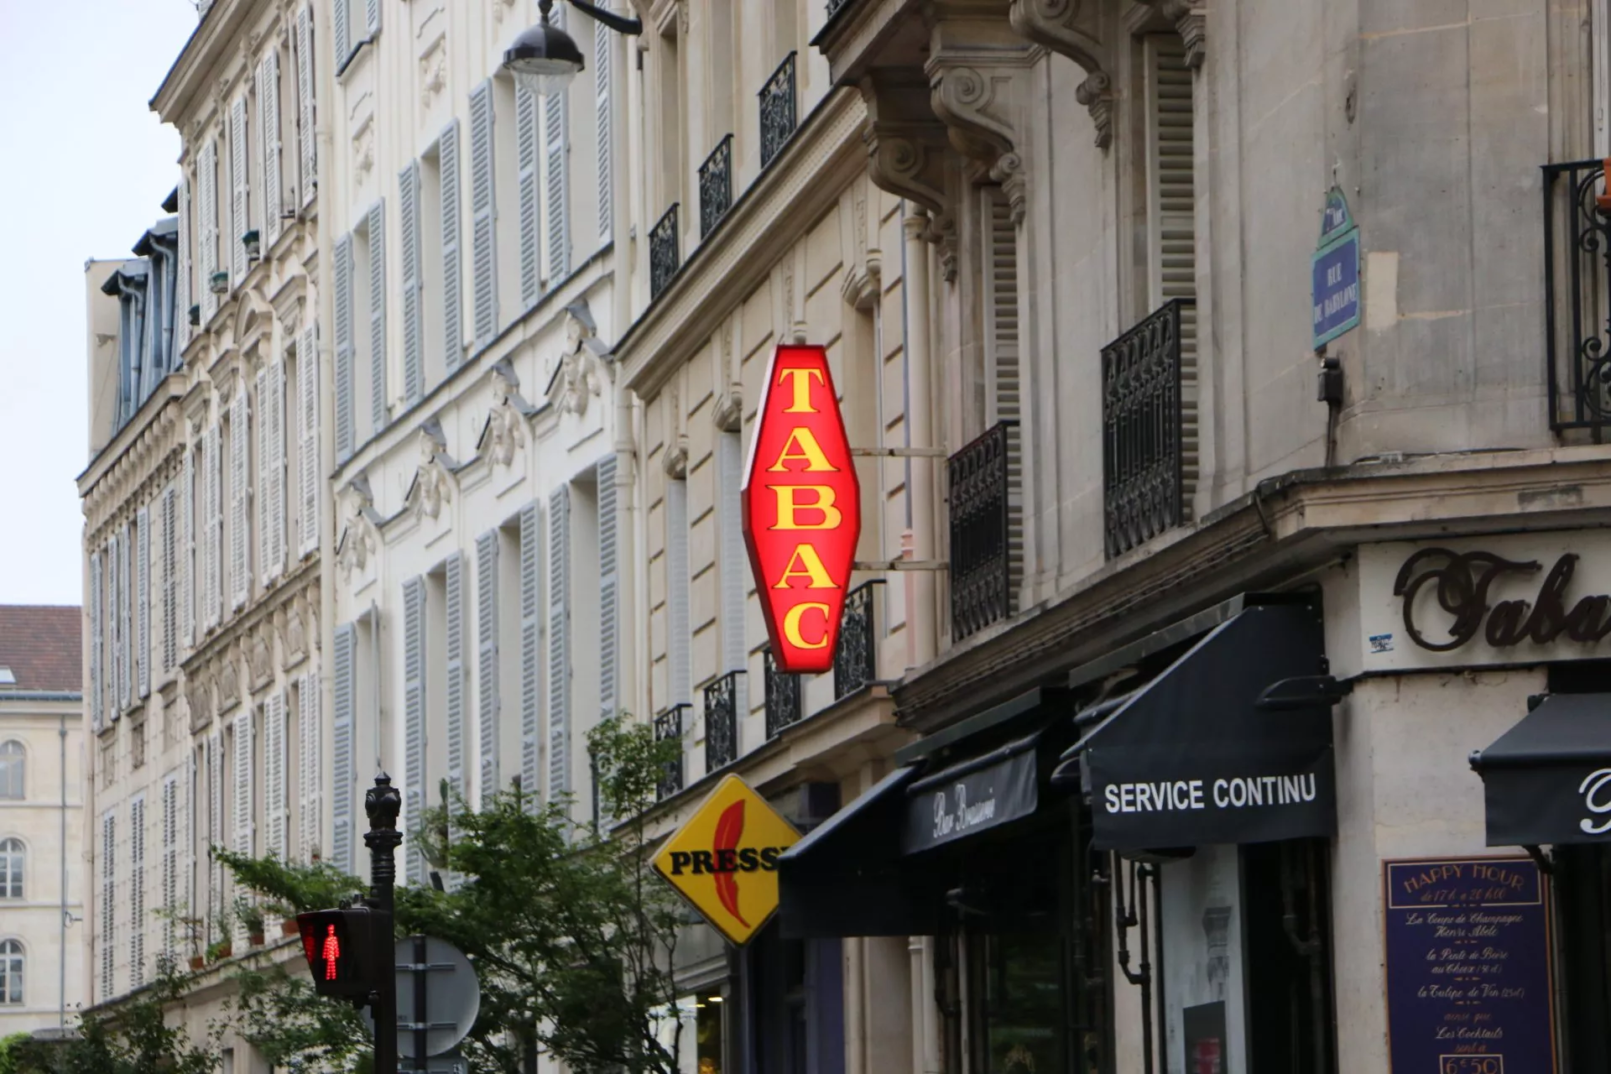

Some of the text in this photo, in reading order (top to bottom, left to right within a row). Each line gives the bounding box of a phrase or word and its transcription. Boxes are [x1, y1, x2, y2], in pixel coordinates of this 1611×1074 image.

[1327, 262, 1342, 287] RUE
[764, 367, 844, 650] TABAC
[1104, 773, 1317, 814] SERVICE CONTINU
[669, 846, 790, 875] PRESS
[1403, 864, 1525, 893] HAPPY HOUR
[1469, 912, 1523, 926] Champagne
[1456, 1026, 1504, 1039] Cocktails
